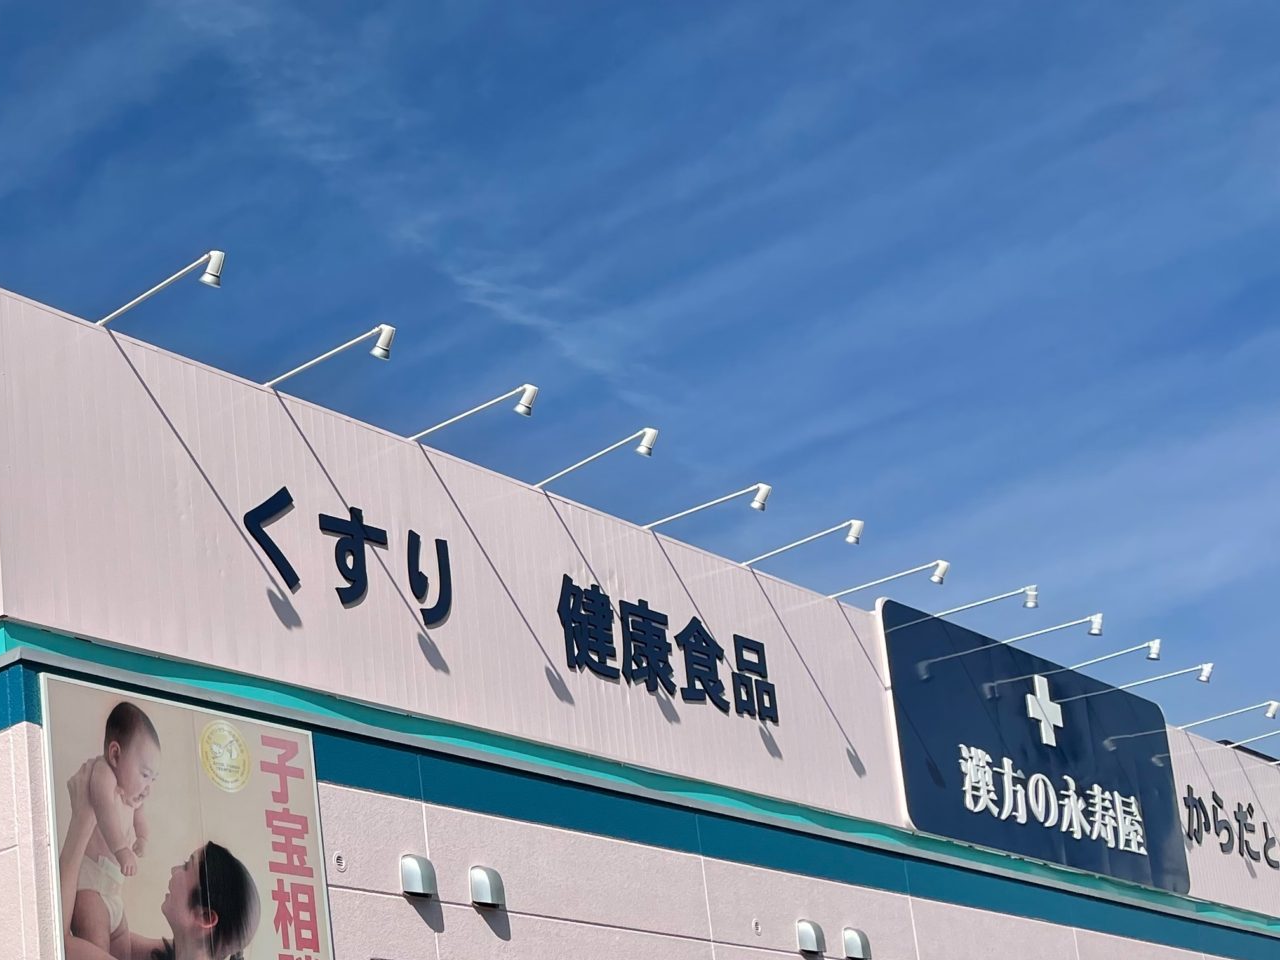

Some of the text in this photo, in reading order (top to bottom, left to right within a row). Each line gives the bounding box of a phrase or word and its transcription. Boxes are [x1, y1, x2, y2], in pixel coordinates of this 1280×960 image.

[243, 486, 779, 726] くすり 健康食品
[958, 743, 1147, 856] 漢方の永寿屋
[1183, 784, 1280, 870] からだと
